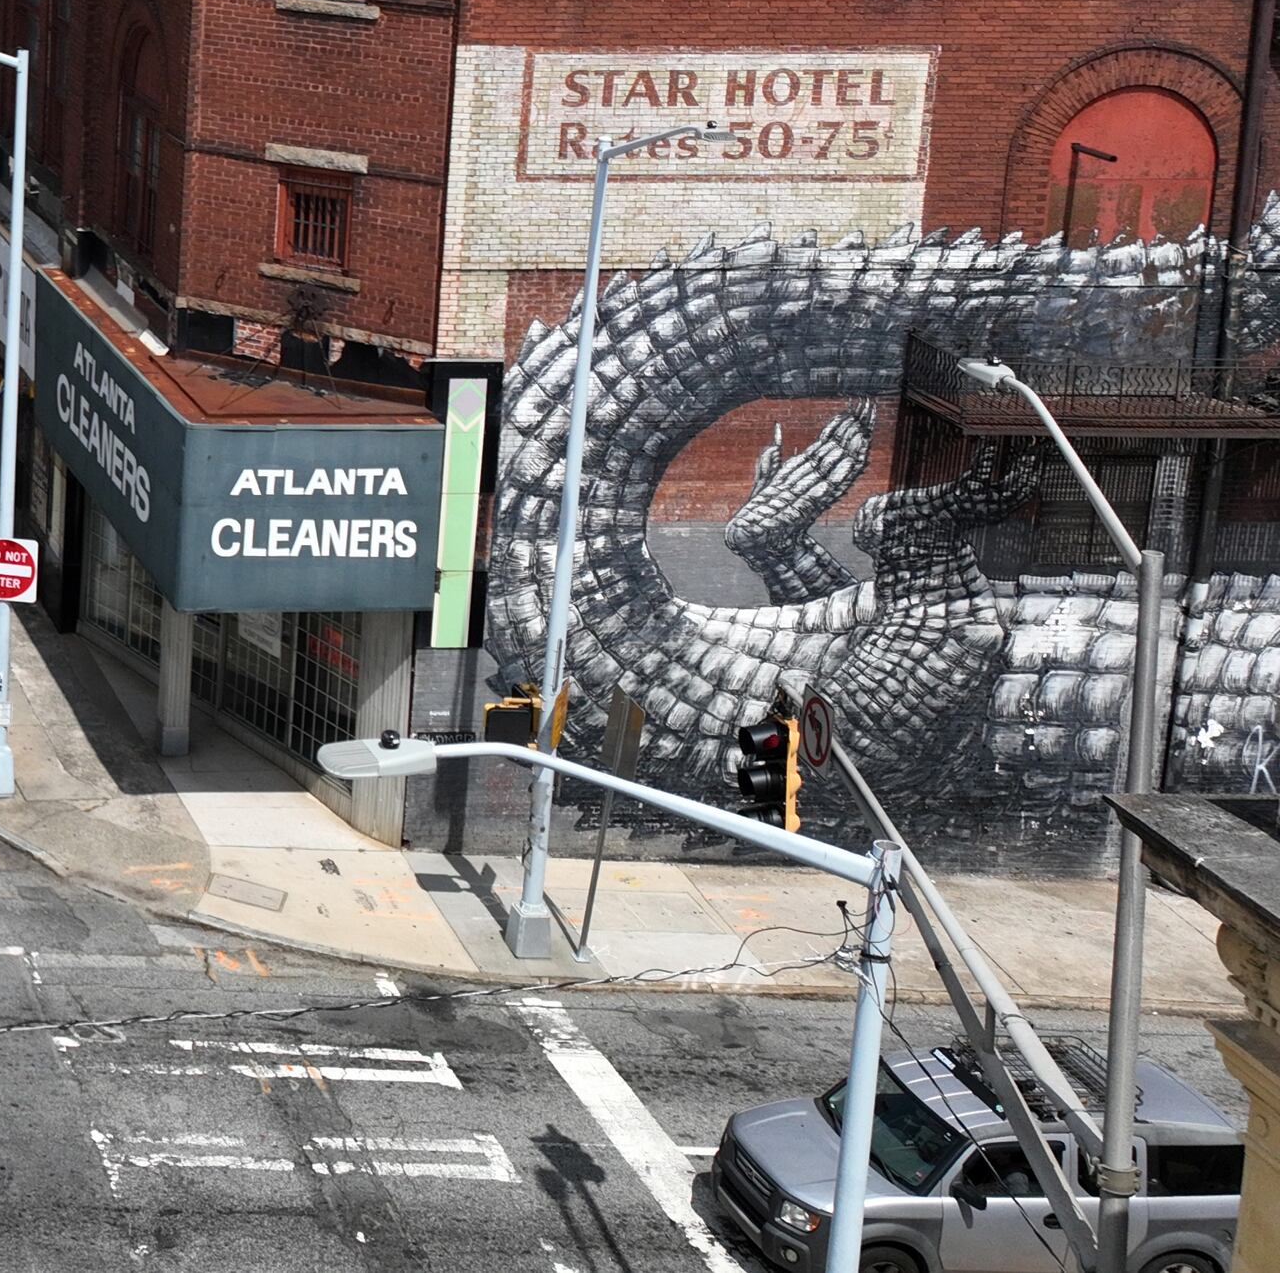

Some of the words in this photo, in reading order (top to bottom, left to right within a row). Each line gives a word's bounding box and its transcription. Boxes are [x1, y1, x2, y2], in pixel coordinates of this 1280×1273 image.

[561, 68, 700, 108] STAR
[725, 67, 896, 107] HOTEL
[557, 121, 700, 160] Rtes
[73, 341, 136, 436] ATLANTA
[56, 373, 151, 523] CLEANERS
[230, 467, 408, 496] ATLANTA
[5, 551, 28, 563] NOT
[210, 517, 418, 559] CLEANERS
